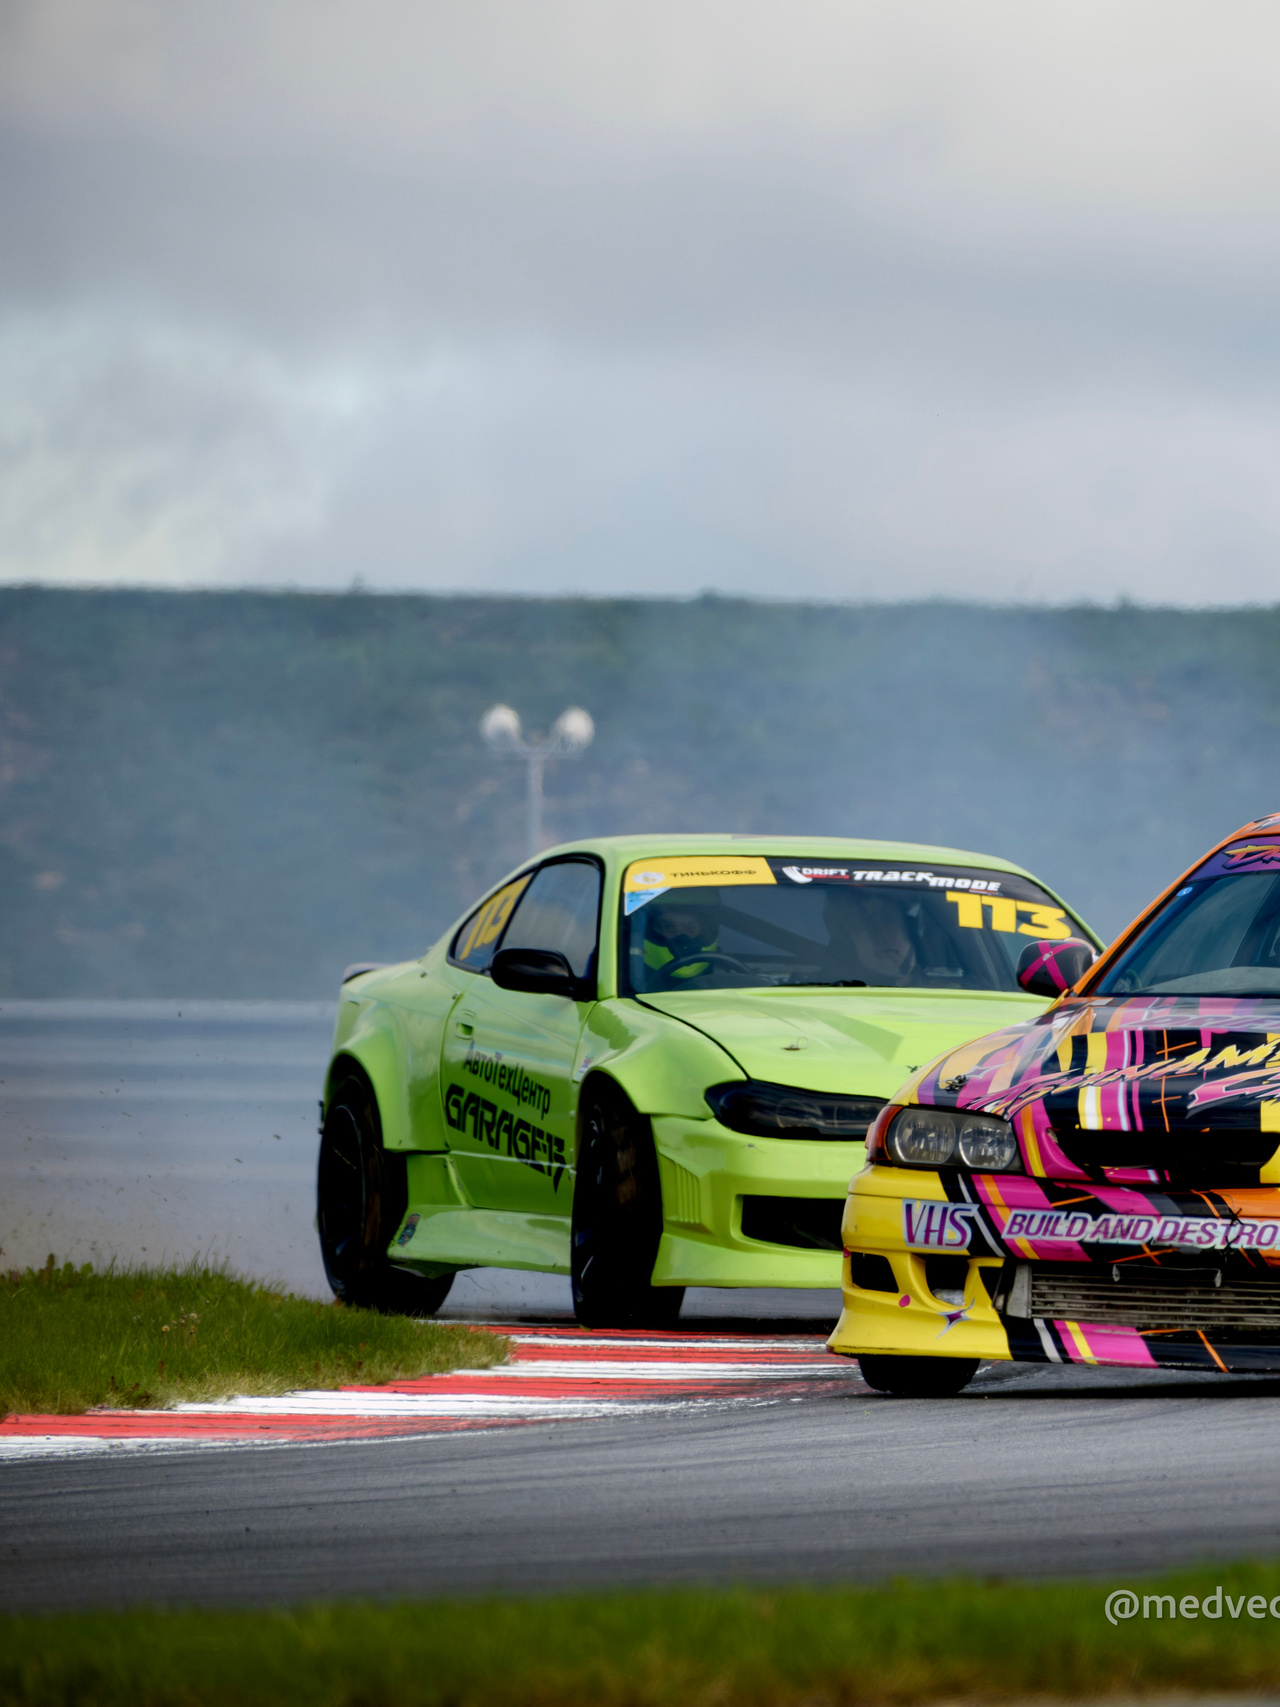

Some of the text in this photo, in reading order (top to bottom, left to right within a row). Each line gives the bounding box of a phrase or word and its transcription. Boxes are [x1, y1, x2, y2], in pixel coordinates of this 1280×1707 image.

[669, 869, 757, 879] ТИНЬКОФФ
[801, 867, 849, 877] DRIFT
[945, 891, 1072, 940] 113
[905, 1203, 974, 1247] VHS
[1006, 1212, 1089, 1238] BUILD
[1091, 1216, 1152, 1241] AND
